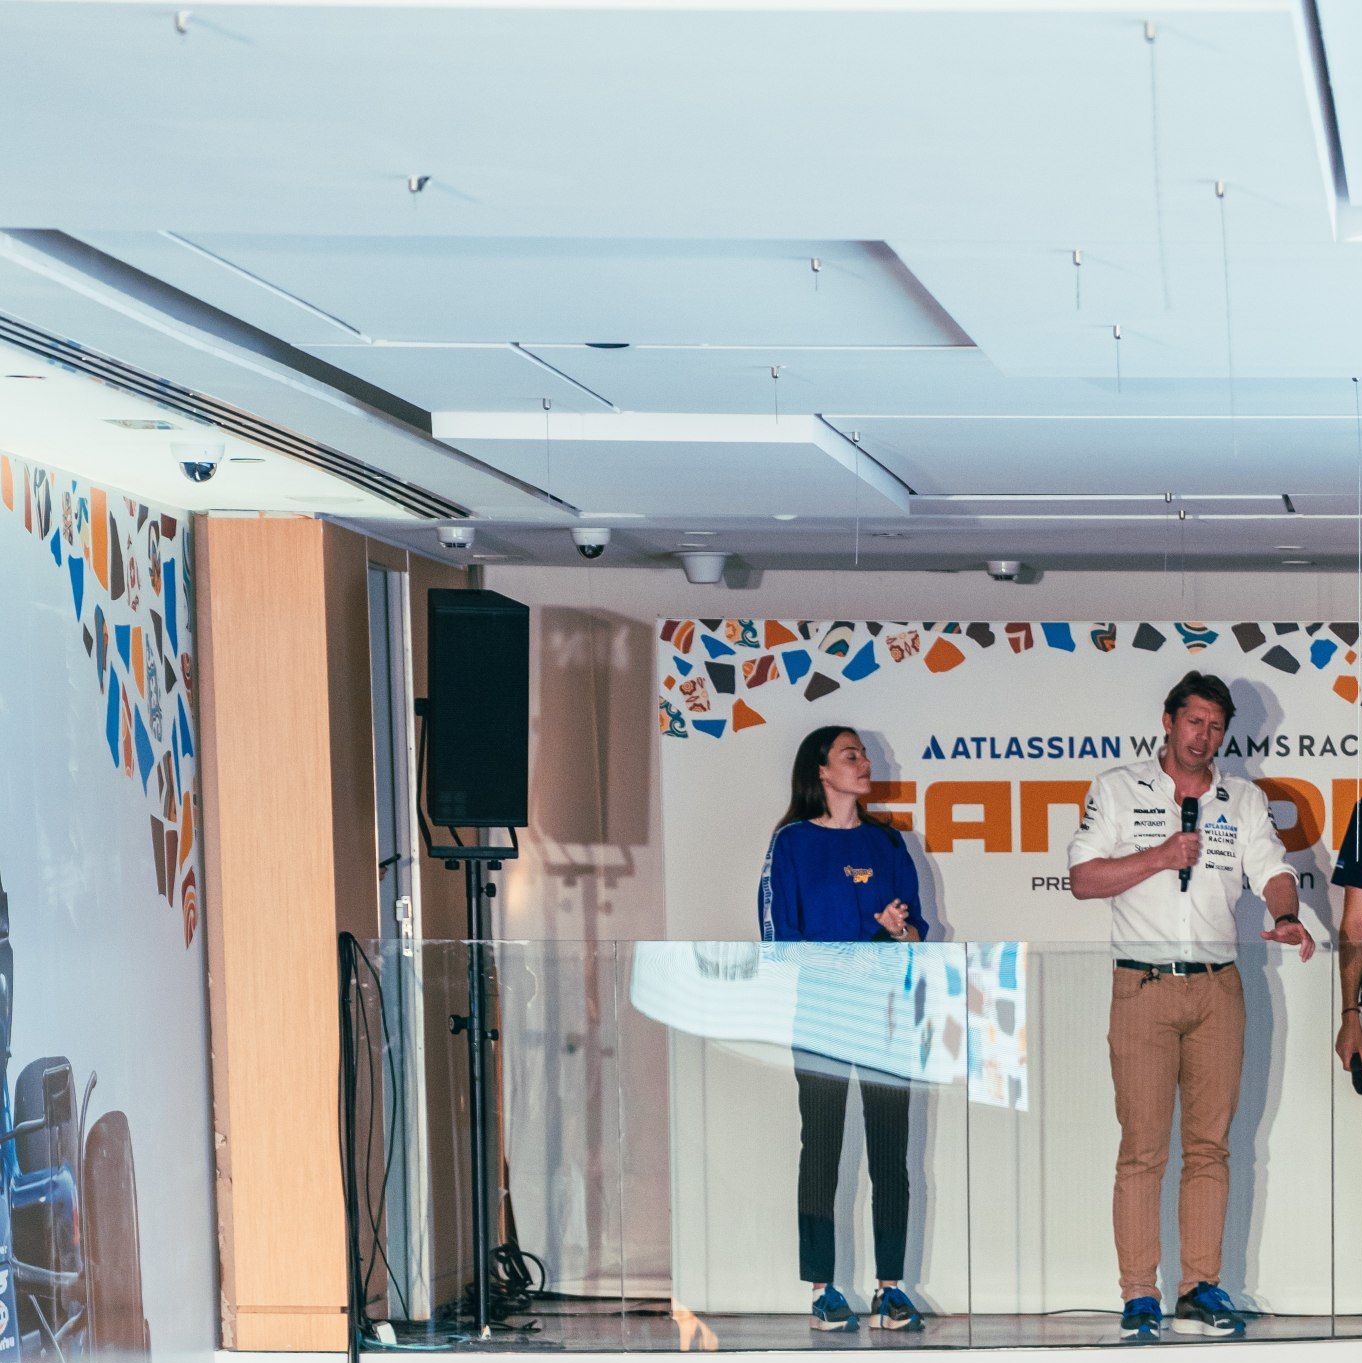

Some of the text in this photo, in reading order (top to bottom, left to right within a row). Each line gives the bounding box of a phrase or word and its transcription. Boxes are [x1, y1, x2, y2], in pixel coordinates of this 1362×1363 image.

[951, 735, 1121, 759] ATLASSIAN
[1130, 734, 1291, 759] WAMS
[1204, 822, 1238, 833] ATLASSIAN
[1204, 829, 1238, 840] WILLIAMS
[1208, 836, 1235, 846] RACING
[1206, 848, 1238, 859] DURACELL
